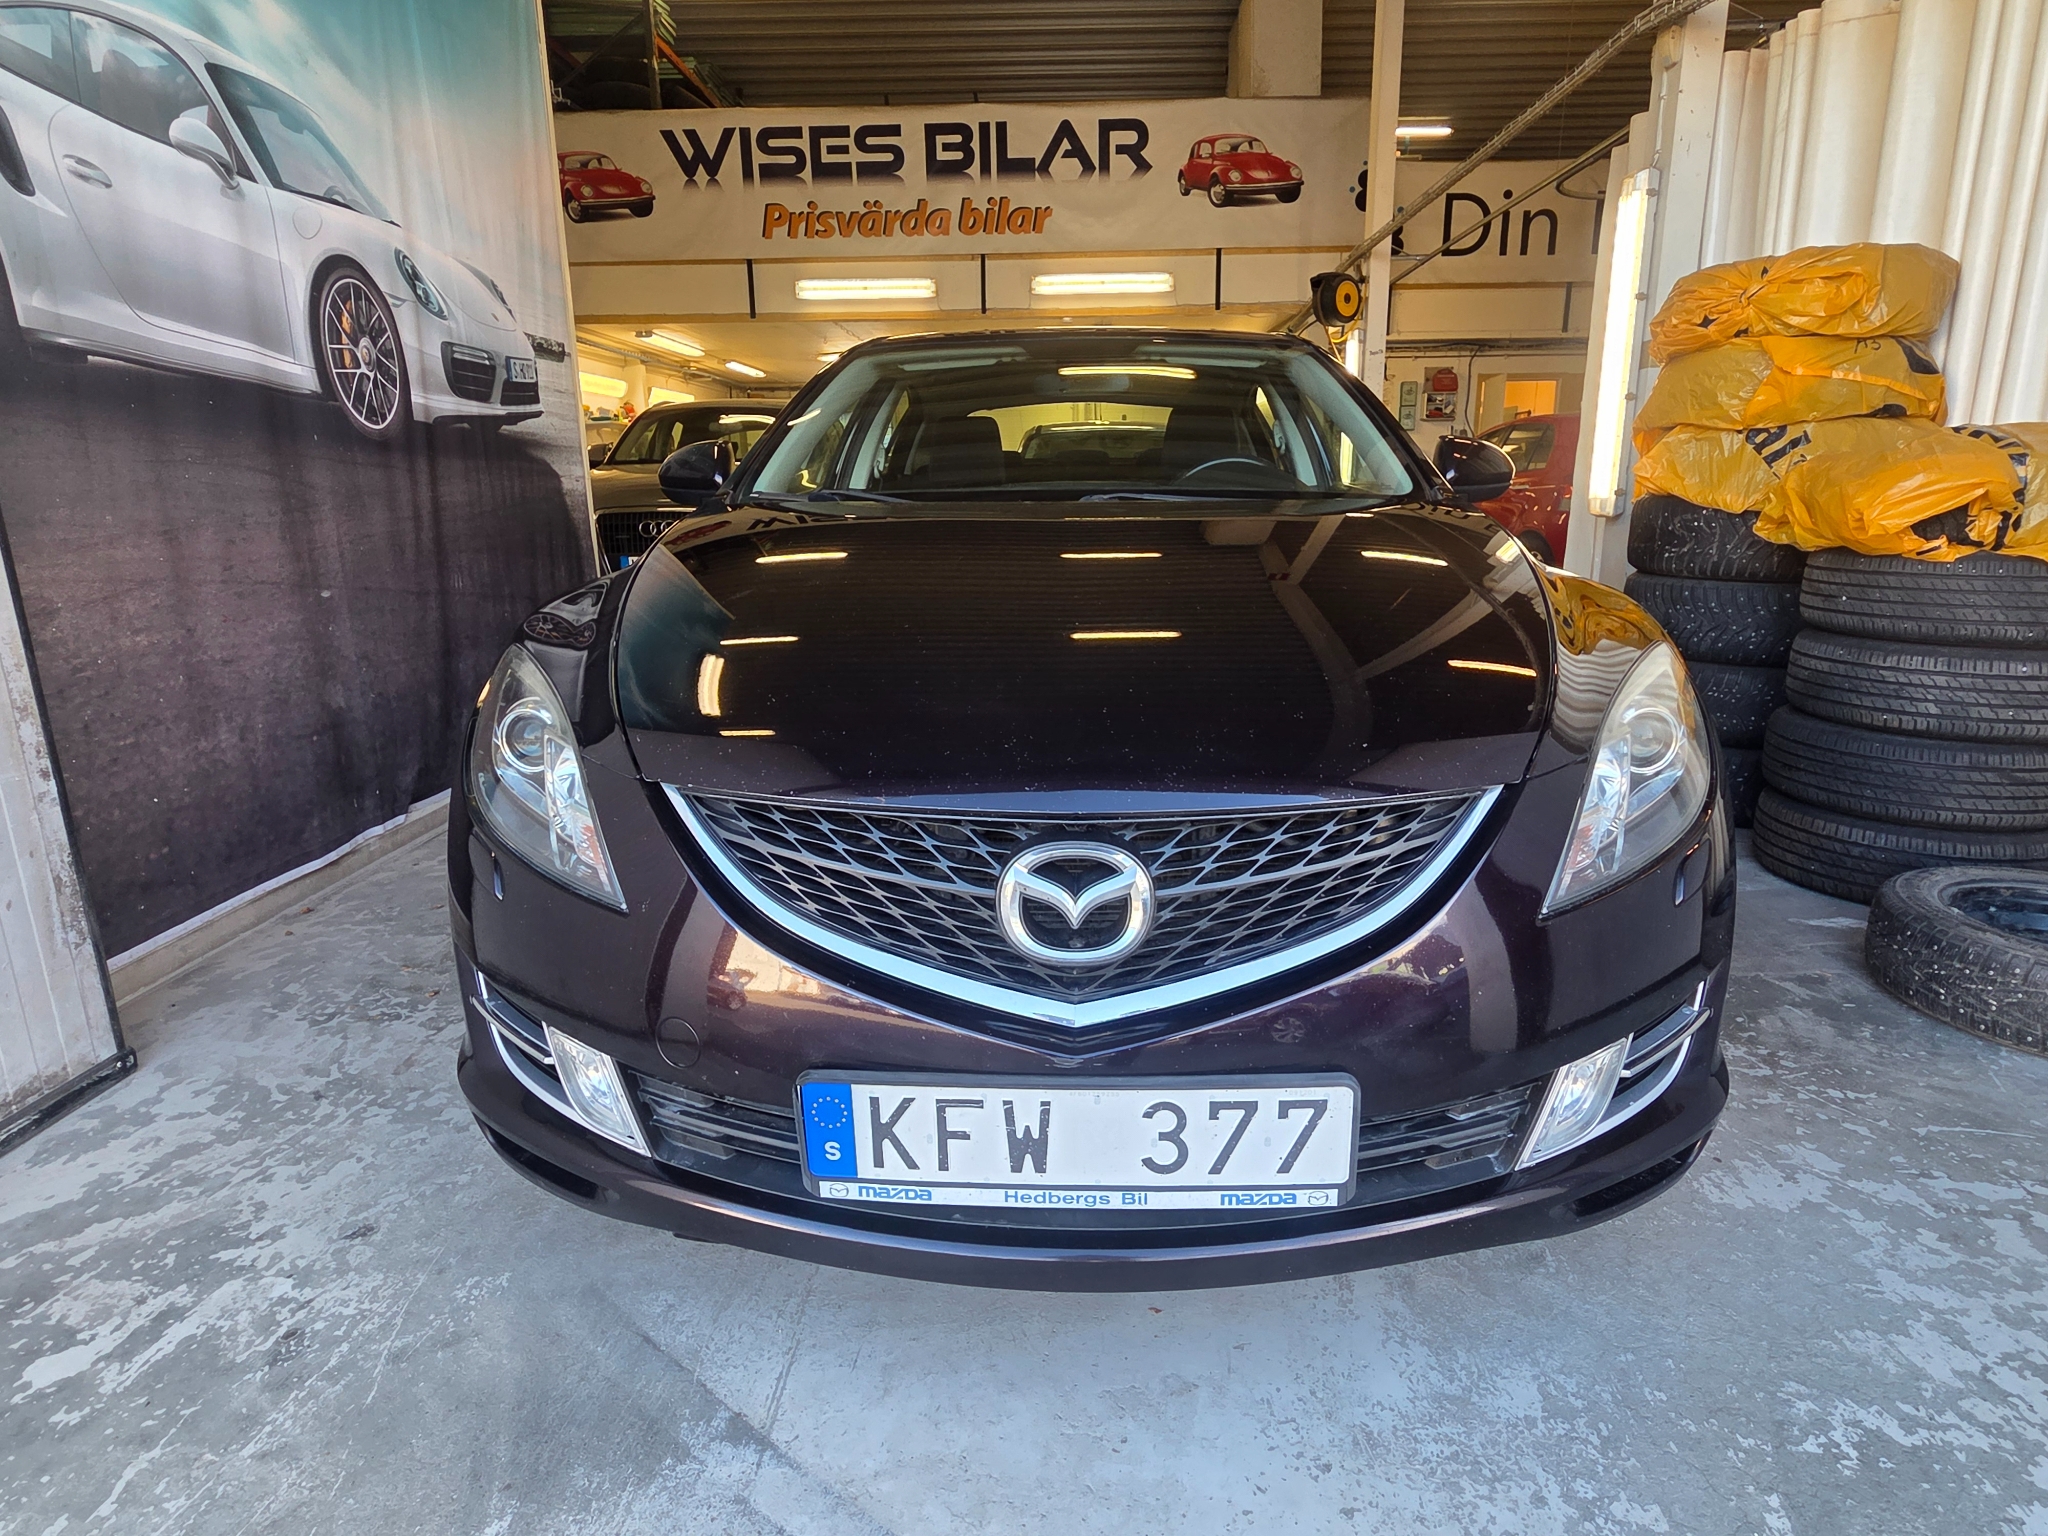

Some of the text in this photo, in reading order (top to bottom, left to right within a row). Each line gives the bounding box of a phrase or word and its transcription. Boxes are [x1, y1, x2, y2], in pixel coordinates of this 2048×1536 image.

[659, 118, 1154, 182] WISES BILAR
[762, 196, 1053, 240] Prisvärda bilar
[1441, 188, 1558, 257] Din
[824, 1141, 842, 1161] S
[869, 1096, 1328, 1174] KFW 377
[1004, 1191, 1111, 1206] Hedbergs
[1121, 1193, 1148, 1206] Bil
